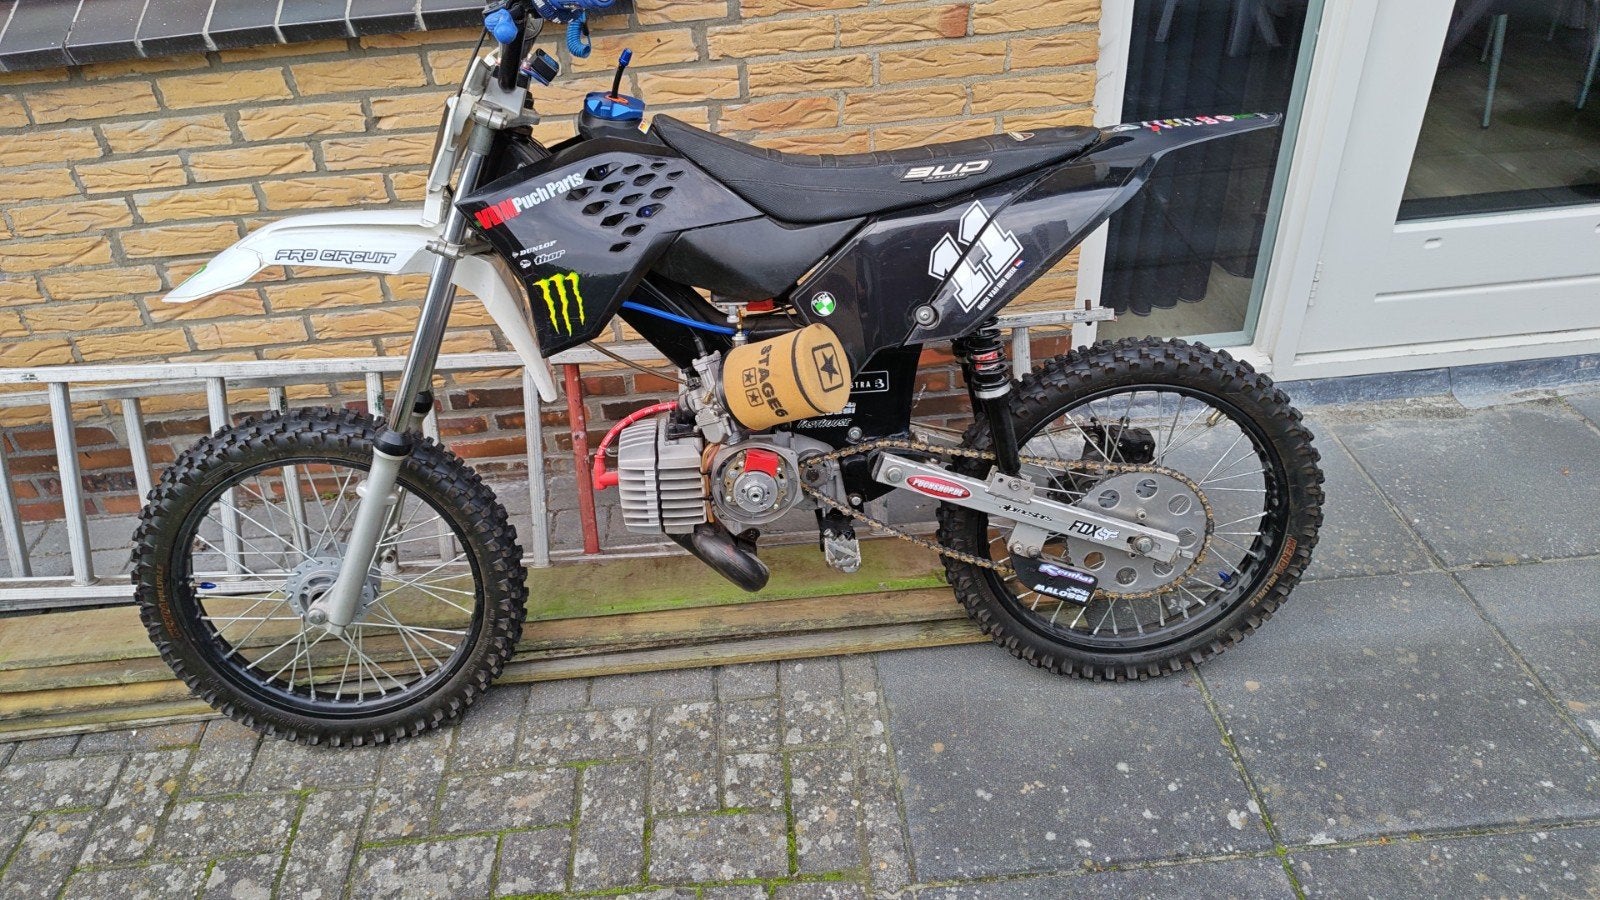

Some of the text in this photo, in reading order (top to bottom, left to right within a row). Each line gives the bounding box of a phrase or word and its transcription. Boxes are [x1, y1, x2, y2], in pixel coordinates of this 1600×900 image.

[904, 160, 990, 179] BUD
[275, 249, 397, 265] PRO CIRCUIT
[518, 240, 557, 257] DUNLOP
[758, 345, 789, 417] STAGE6
[1068, 520, 1099, 537] FOX
